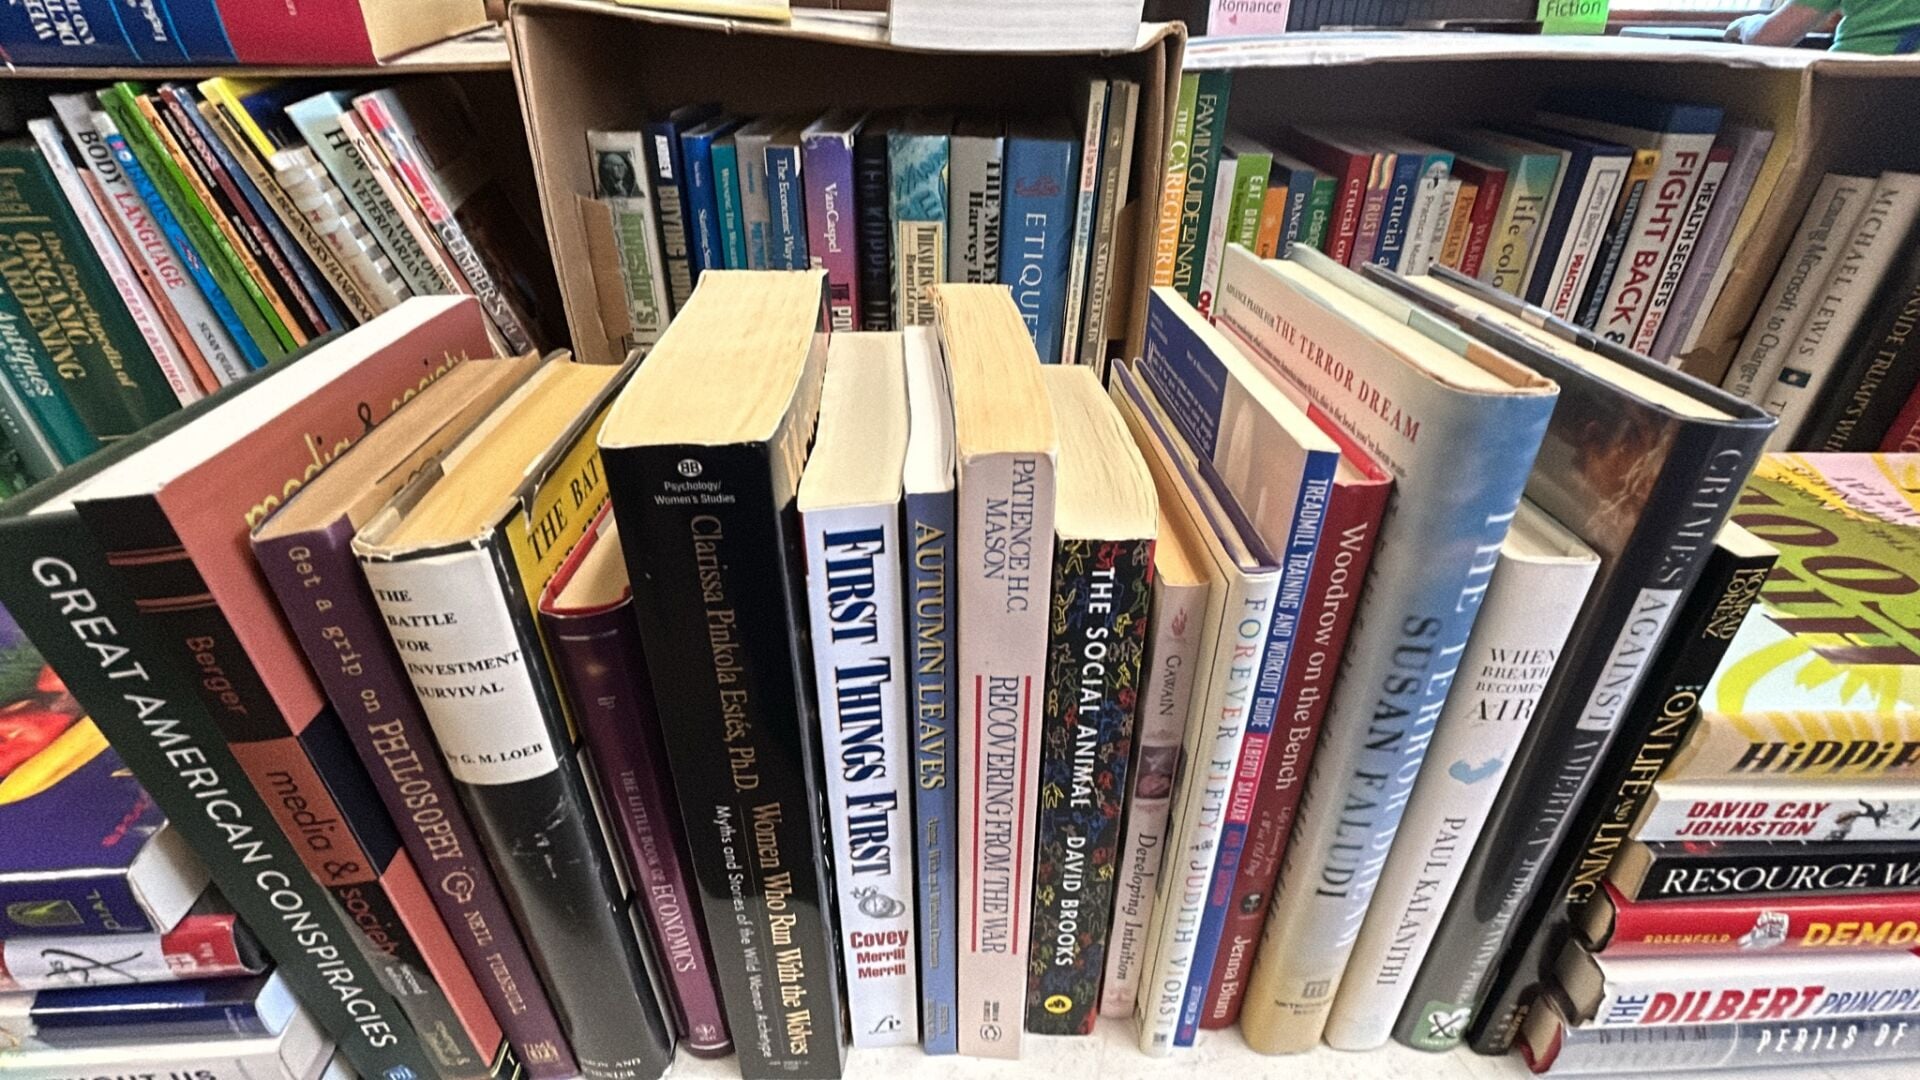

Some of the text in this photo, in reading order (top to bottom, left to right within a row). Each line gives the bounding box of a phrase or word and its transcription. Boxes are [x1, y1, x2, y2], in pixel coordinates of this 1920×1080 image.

[1218, 0, 1281, 13] Romance
[1545, 0, 1602, 17] Fiction
[1192, 93, 1217, 164] FAMILY
[322, 125, 366, 172] HOW
[379, 196, 399, 220] BE
[986, 160, 1001, 203] THE
[1156, 107, 1188, 266] THE CAREGIVER
[1181, 163, 1207, 228] GUIDE
[78, 131, 127, 184] BODY
[115, 191, 187, 289] LANGUAGE
[352, 177, 421, 278] VETERINARIAN
[658, 186, 687, 256] BUYING
[777, 158, 796, 263] The Economic Way
[824, 182, 841, 253] VanCaspel
[965, 191, 984, 266] Harvey
[1288, 192, 1305, 231] DANCE
[1340, 178, 1360, 237] crucial
[1362, 195, 1384, 237] TRUST
[1384, 184, 1409, 251] crucial
[1508, 195, 1544, 237] life
[1608, 151, 1699, 326] FIGHT BACK
[1643, 181, 1717, 334] HEALTH SECRETS FOR
[14, 231, 93, 345] ORGANIC
[1556, 253, 1585, 312] PRACTICAL
[1800, 188, 1899, 356] MICHAEL LEWIS
[0, 233, 87, 380] GARDENING
[1770, 317, 1785, 333] to
[1274, 313, 1296, 346] THE
[1300, 333, 1355, 392] TERROR
[1358, 378, 1422, 444] DREAM
[1744, 331, 1782, 387] Change
[1846, 352, 1897, 425] TRUMP'S
[654, 492, 737, 506] Women's Studies
[663, 480, 722, 492] Psychology/
[1292, 478, 1330, 549] TREADMILL
[526, 517, 569, 564] THE
[983, 497, 1009, 580] MASON
[1006, 458, 1036, 614] PATIENCE H.C.
[376, 588, 412, 603] THE
[915, 520, 945, 679] AUTUMN
[1279, 552, 1315, 612] TRAINING
[1315, 522, 1369, 647] Woodrow
[1702, 569, 1750, 640] LORENZ
[1718, 568, 1768, 641] KONRAD
[387, 612, 458, 628] BATTLE
[397, 639, 432, 653] FOR
[1272, 612, 1296, 639] AND
[1528, 449, 1743, 846] CRIMES AGAINST AMERICA
[186, 636, 248, 716] Berger
[406, 650, 522, 677] INVESTMENT
[690, 514, 760, 795] Clarissa Pinkola Ph.D.
[1216, 597, 1268, 741] FOREVER
[1259, 640, 1293, 695] WORKOUT
[1303, 651, 1328, 681] on
[1365, 615, 1442, 753] SUSAN
[1481, 666, 1551, 679] BREATH
[1491, 648, 1558, 665] WHEN
[416, 682, 505, 700] SURVIVAL
[823, 524, 898, 877] FIRST THINGS FIRST
[1159, 654, 1182, 717] GAWAIN
[1251, 695, 1276, 729] GUIDE
[1293, 686, 1322, 722] the
[1473, 698, 1535, 722] AIR
[1475, 682, 1545, 694] BECOMES
[288, 546, 494, 948] Get a grip on PHILOSOPHY NEIL
[461, 743, 544, 765] G. M. LOEB
[917, 683, 946, 790] LEAVES
[1239, 735, 1268, 781] ALBERTO
[1275, 723, 1312, 791] Bench
[1055, 567, 1116, 967] THE SOCIAL ANIMAL DAVID BROOKS
[1198, 759, 1232, 834] FIFTY
[1566, 690, 1698, 903] ON LIFE LIVING
[31, 557, 398, 1049] GREAT AMERICAN CONSPIRACIES
[712, 803, 733, 844] Myths
[981, 675, 1019, 954] RECOVERING FROM THE WAR
[1229, 780, 1254, 822] SALAZAR
[1675, 821, 1817, 836] JOHNSTON
[1687, 801, 1833, 819] DAVID CAY
[267, 771, 399, 957] media & society
[724, 845, 744, 872] and
[751, 800, 783, 869] Women
[1315, 770, 1389, 899] FALUDI
[620, 769, 698, 974] THE LITTLE BOOK ECONOMICS
[728, 871, 747, 913] Stories
[764, 870, 793, 912] Who
[1376, 816, 1468, 986] PAUL KALANITHI
[1660, 864, 1876, 894] RESOURCE
[769, 912, 796, 946] Run
[1116, 832, 1158, 981] Developing Intuition
[1174, 860, 1209, 945] JUDITH
[739, 926, 757, 946] the
[743, 946, 760, 974] Wild
[776, 946, 805, 984] With
[850, 929, 909, 950] Covey
[856, 949, 906, 964] Merrill
[1220, 935, 1252, 982] Jenna
[1643, 933, 1731, 945] ROSENFELD
[781, 984, 807, 1008] the
[857, 964, 907, 979] Merrill
[1159, 956, 1188, 1031] VIORST
[1213, 979, 1240, 1020] Blum
[785, 1007, 813, 1057] Wolves
[1604, 985, 1826, 1025] THE DILBERT
[1756, 1022, 1909, 1054] PERILS OF
